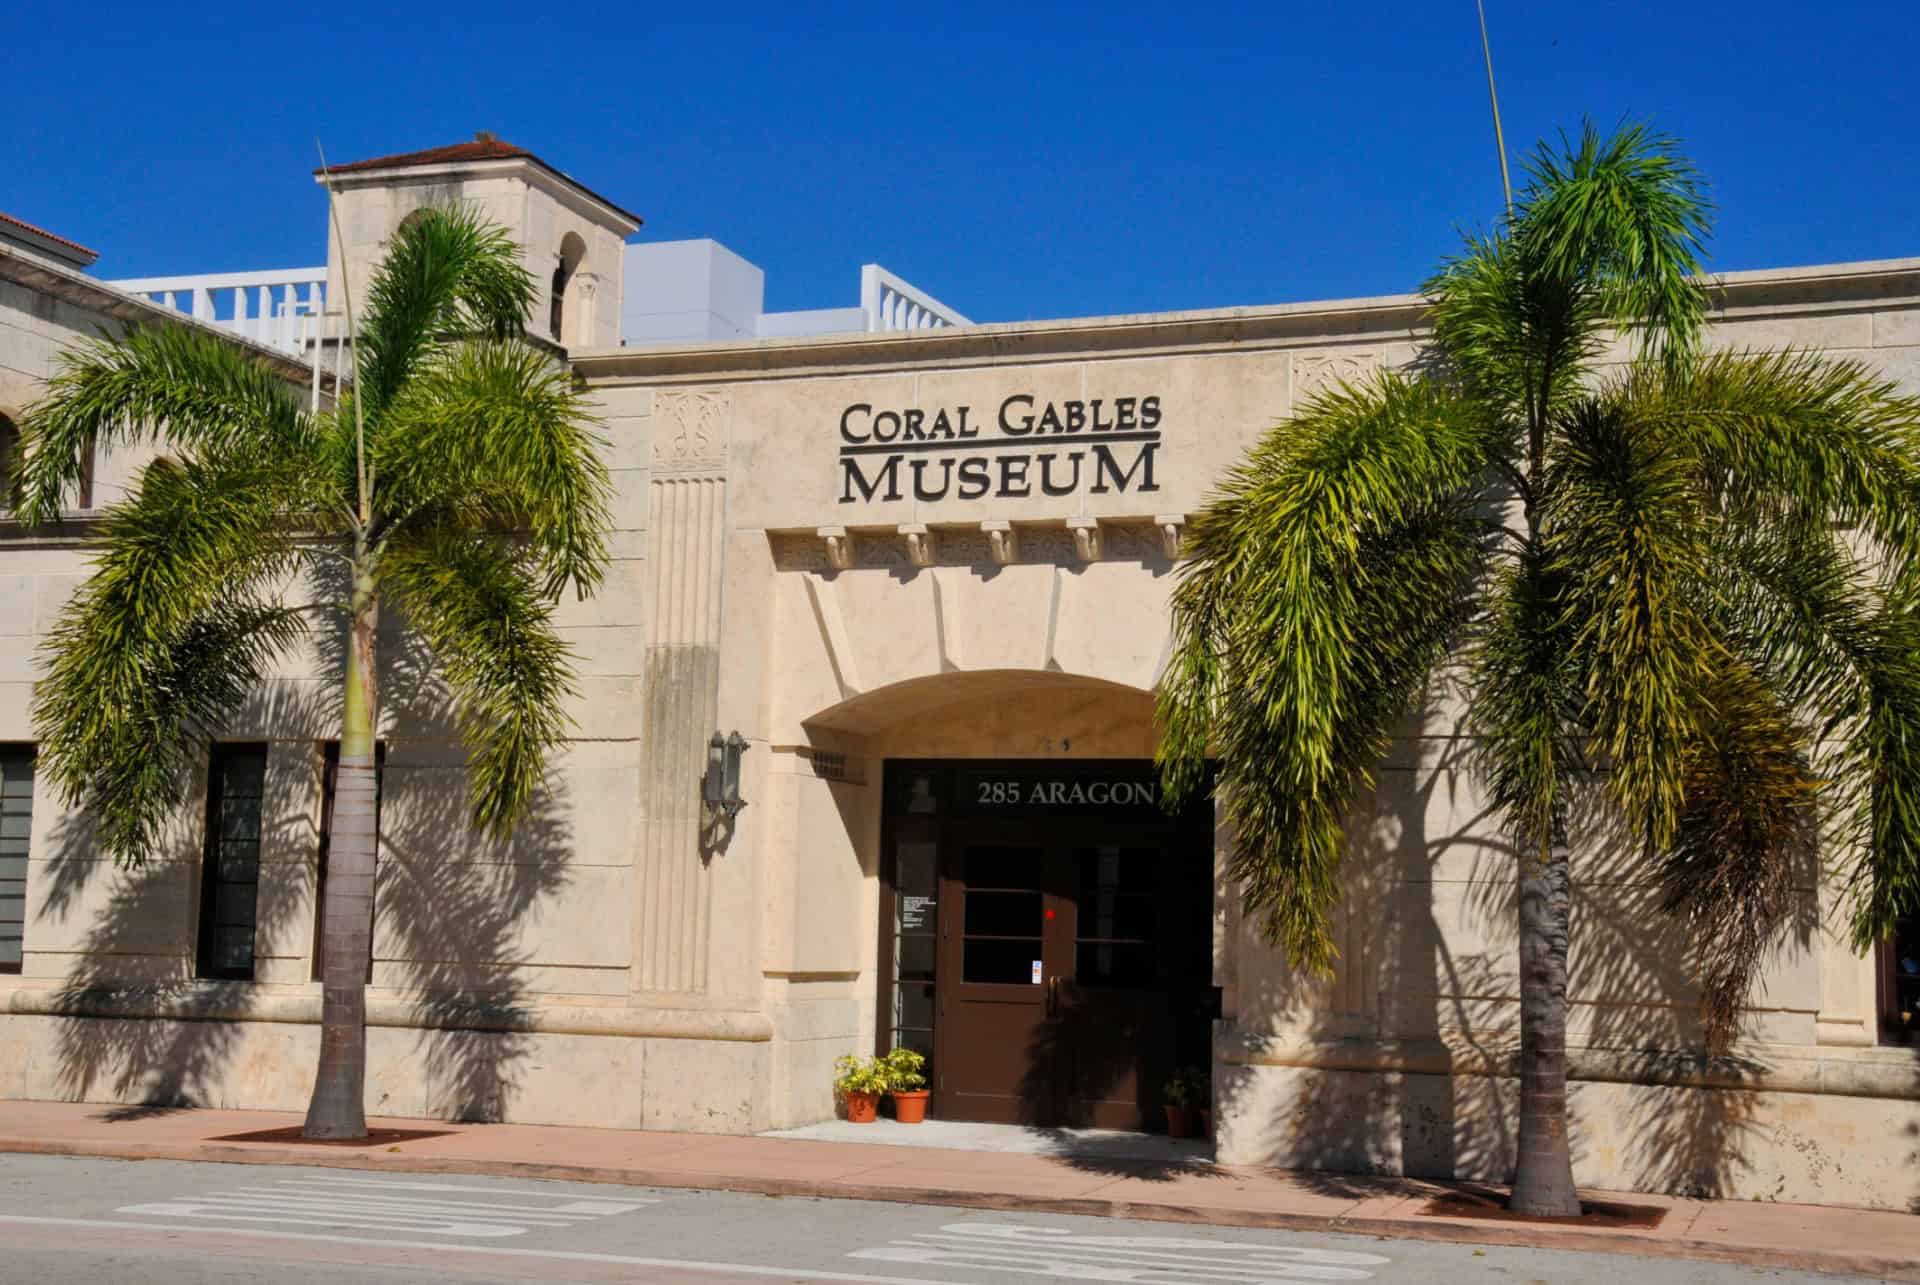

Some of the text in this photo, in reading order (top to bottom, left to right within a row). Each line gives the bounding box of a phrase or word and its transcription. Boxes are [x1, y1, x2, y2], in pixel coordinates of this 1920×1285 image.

[840, 394, 1162, 443] CORAL GABLES
[838, 442, 1161, 504] MUSEUM
[977, 782, 1155, 804] 285 ARAGON
